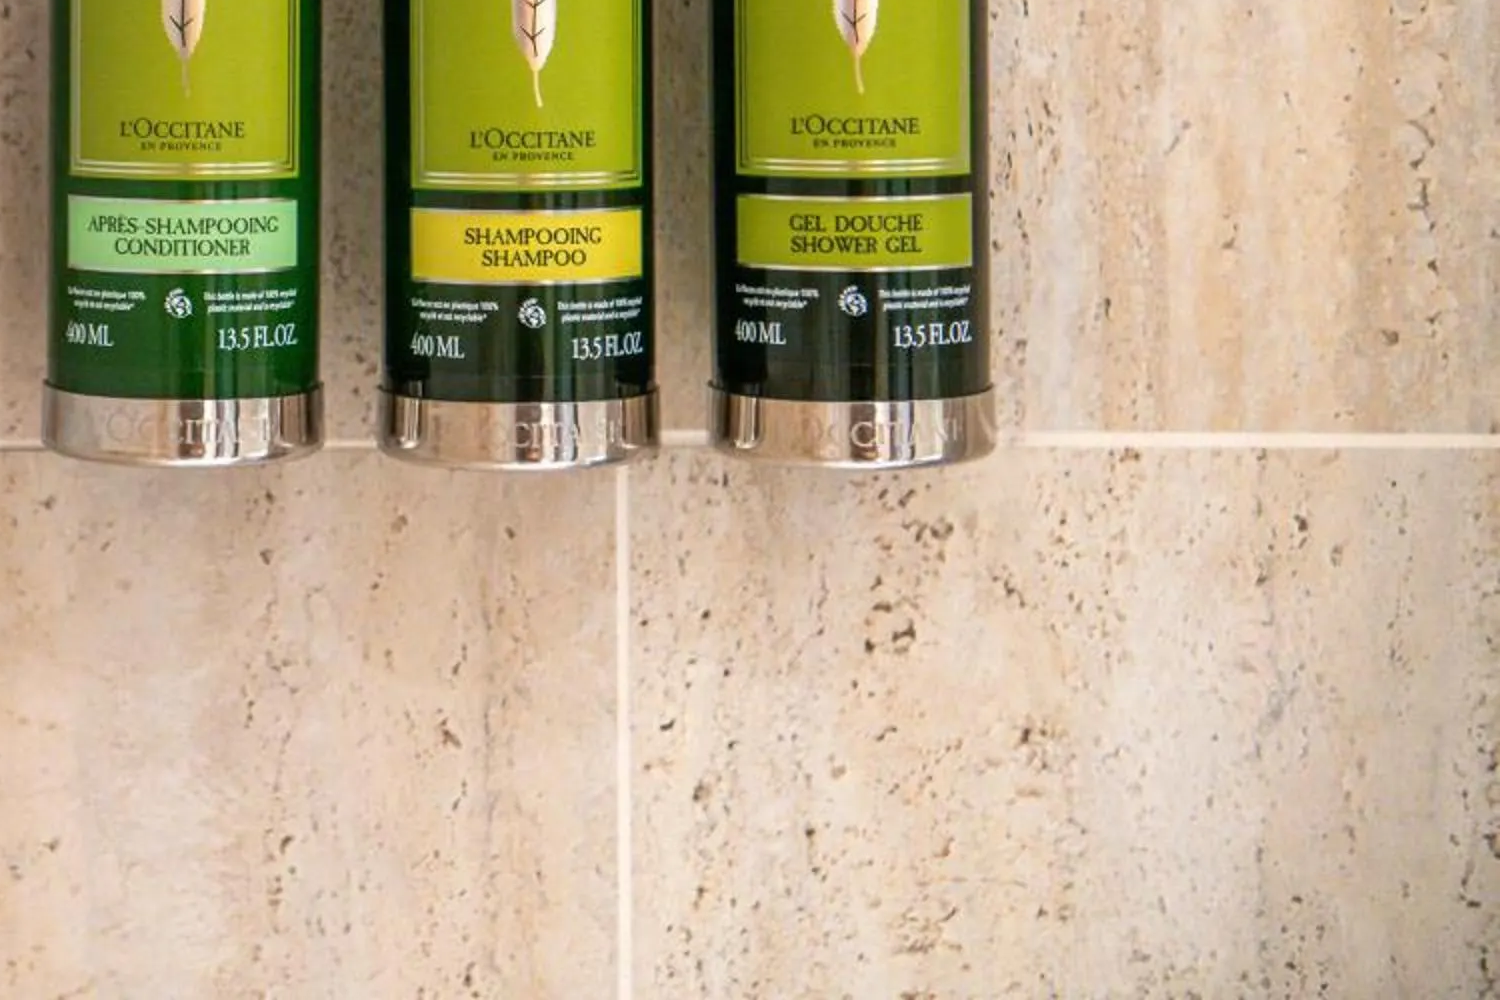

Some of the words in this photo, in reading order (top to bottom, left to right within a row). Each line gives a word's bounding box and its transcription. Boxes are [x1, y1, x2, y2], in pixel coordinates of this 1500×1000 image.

[119, 116, 246, 139] L'OCCITANE
[790, 113, 920, 136] L'OCCITANE
[469, 127, 597, 150] L'OCCITANE
[87, 214, 279, 236] APRÈS-SHAMPOOING
[789, 213, 827, 233] GEL
[834, 213, 924, 233] DOUCHE
[114, 237, 251, 257] CONDITIONER
[464, 226, 602, 246] SHAMPOOING
[790, 235, 879, 254] SHOWER
[884, 235, 923, 253] GEL
[481, 249, 587, 267] SHAMPOO
[87, 323, 115, 347] ML
[218, 327, 250, 350] 13.5
[735, 318, 757, 343] 400
[758, 321, 787, 345] ML
[893, 325, 927, 349] 13.5
[410, 331, 435, 357] 400
[436, 335, 465, 359] ML
[571, 336, 602, 360] 13.5
